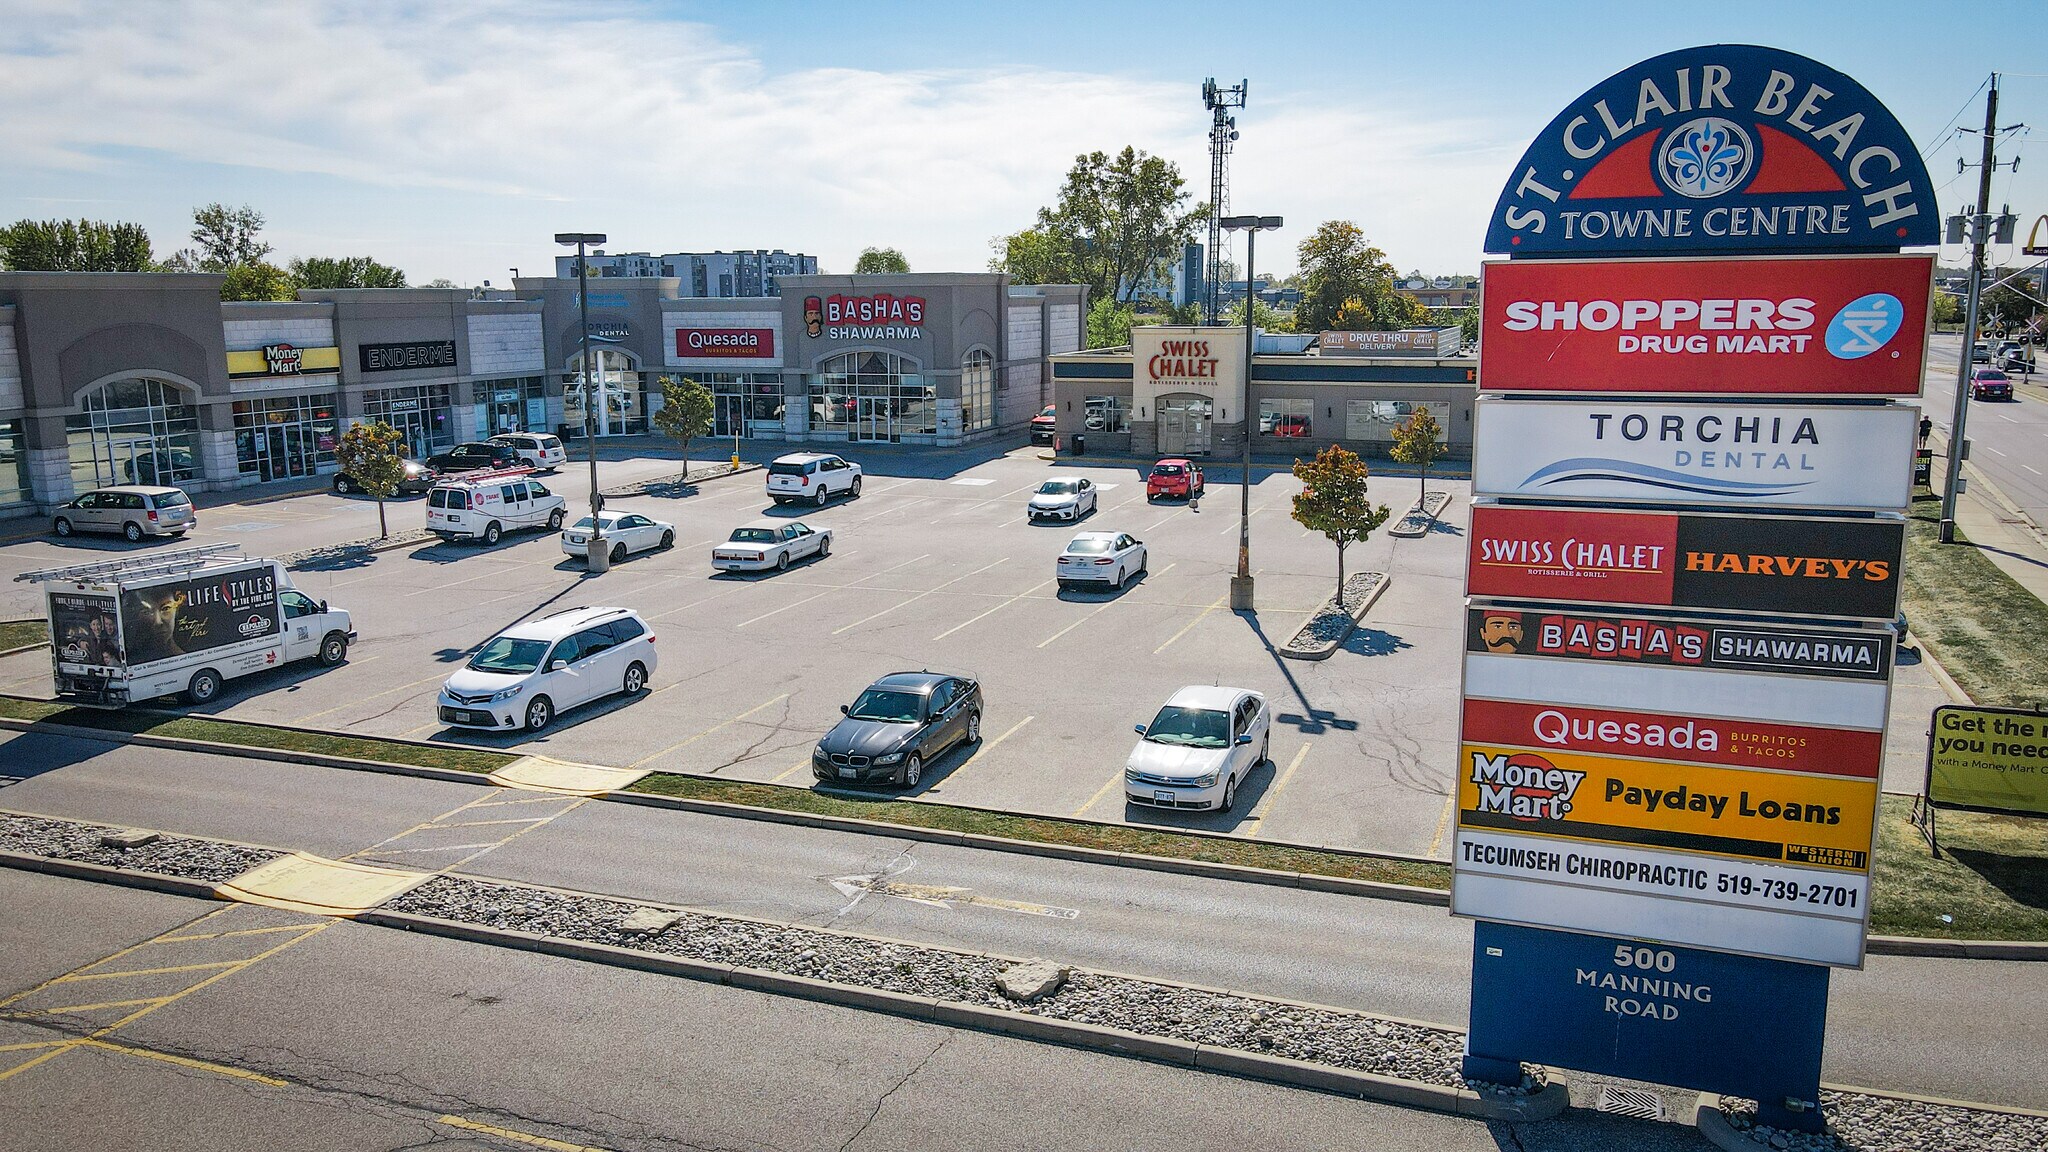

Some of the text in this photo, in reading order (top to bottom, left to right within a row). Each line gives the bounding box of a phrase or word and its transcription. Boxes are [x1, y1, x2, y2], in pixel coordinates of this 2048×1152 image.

[1504, 64, 1918, 234] ST. CLAIR BEACH
[1560, 204, 1850, 240] TOWNE CENTRE
[828, 299, 923, 323] BASHA'S
[1503, 297, 1816, 332] SHOPPERS
[688, 331, 758, 348] Quesada
[829, 327, 921, 339] SHAWARMA
[1349, 333, 1409, 342] DRIVE THRU
[1618, 334, 1812, 354] DRUG MART
[266, 346, 304, 363] Money
[368, 341, 454, 368] ENDERMÉ
[1161, 341, 1209, 357] SWISS
[271, 360, 301, 374] Mart
[1149, 354, 1219, 380] CHALET
[1590, 413, 1820, 445] TORCHIA
[1675, 450, 1815, 471] DENTAL
[1480, 537, 1664, 571] SWISS CHALET
[1527, 569, 1574, 577] ROTISSERIE
[1686, 551, 1889, 582] HARVEY'S
[240, 597, 250, 605] THE
[1541, 623, 1703, 660] BASHA'S
[1719, 637, 1872, 665] SHAWARMA
[1532, 709, 1719, 752] Quesada
[1941, 713, 1986, 734] Get
[1993, 718, 2035, 737] the
[1730, 732, 1808, 747] BURRITOS
[1730, 744, 1796, 759] & TACOS
[1938, 736, 1985, 755] you
[1470, 752, 1587, 802] Money
[1937, 758, 1960, 767] with
[1972, 760, 2007, 772] Money
[2010, 764, 2036, 774] Mart
[1478, 785, 1565, 820] Mart
[1605, 778, 1841, 824] Payday Loans
[1788, 845, 1854, 859] WESTERN
[1808, 854, 1853, 867] UNION
[1462, 841, 1858, 909] TECUMSEH CHIROPRACTIC 519-739-2701
[1613, 946, 1676, 973] 500
[1575, 968, 1712, 1004] MANNING
[1604, 996, 1679, 1021] ROAD
